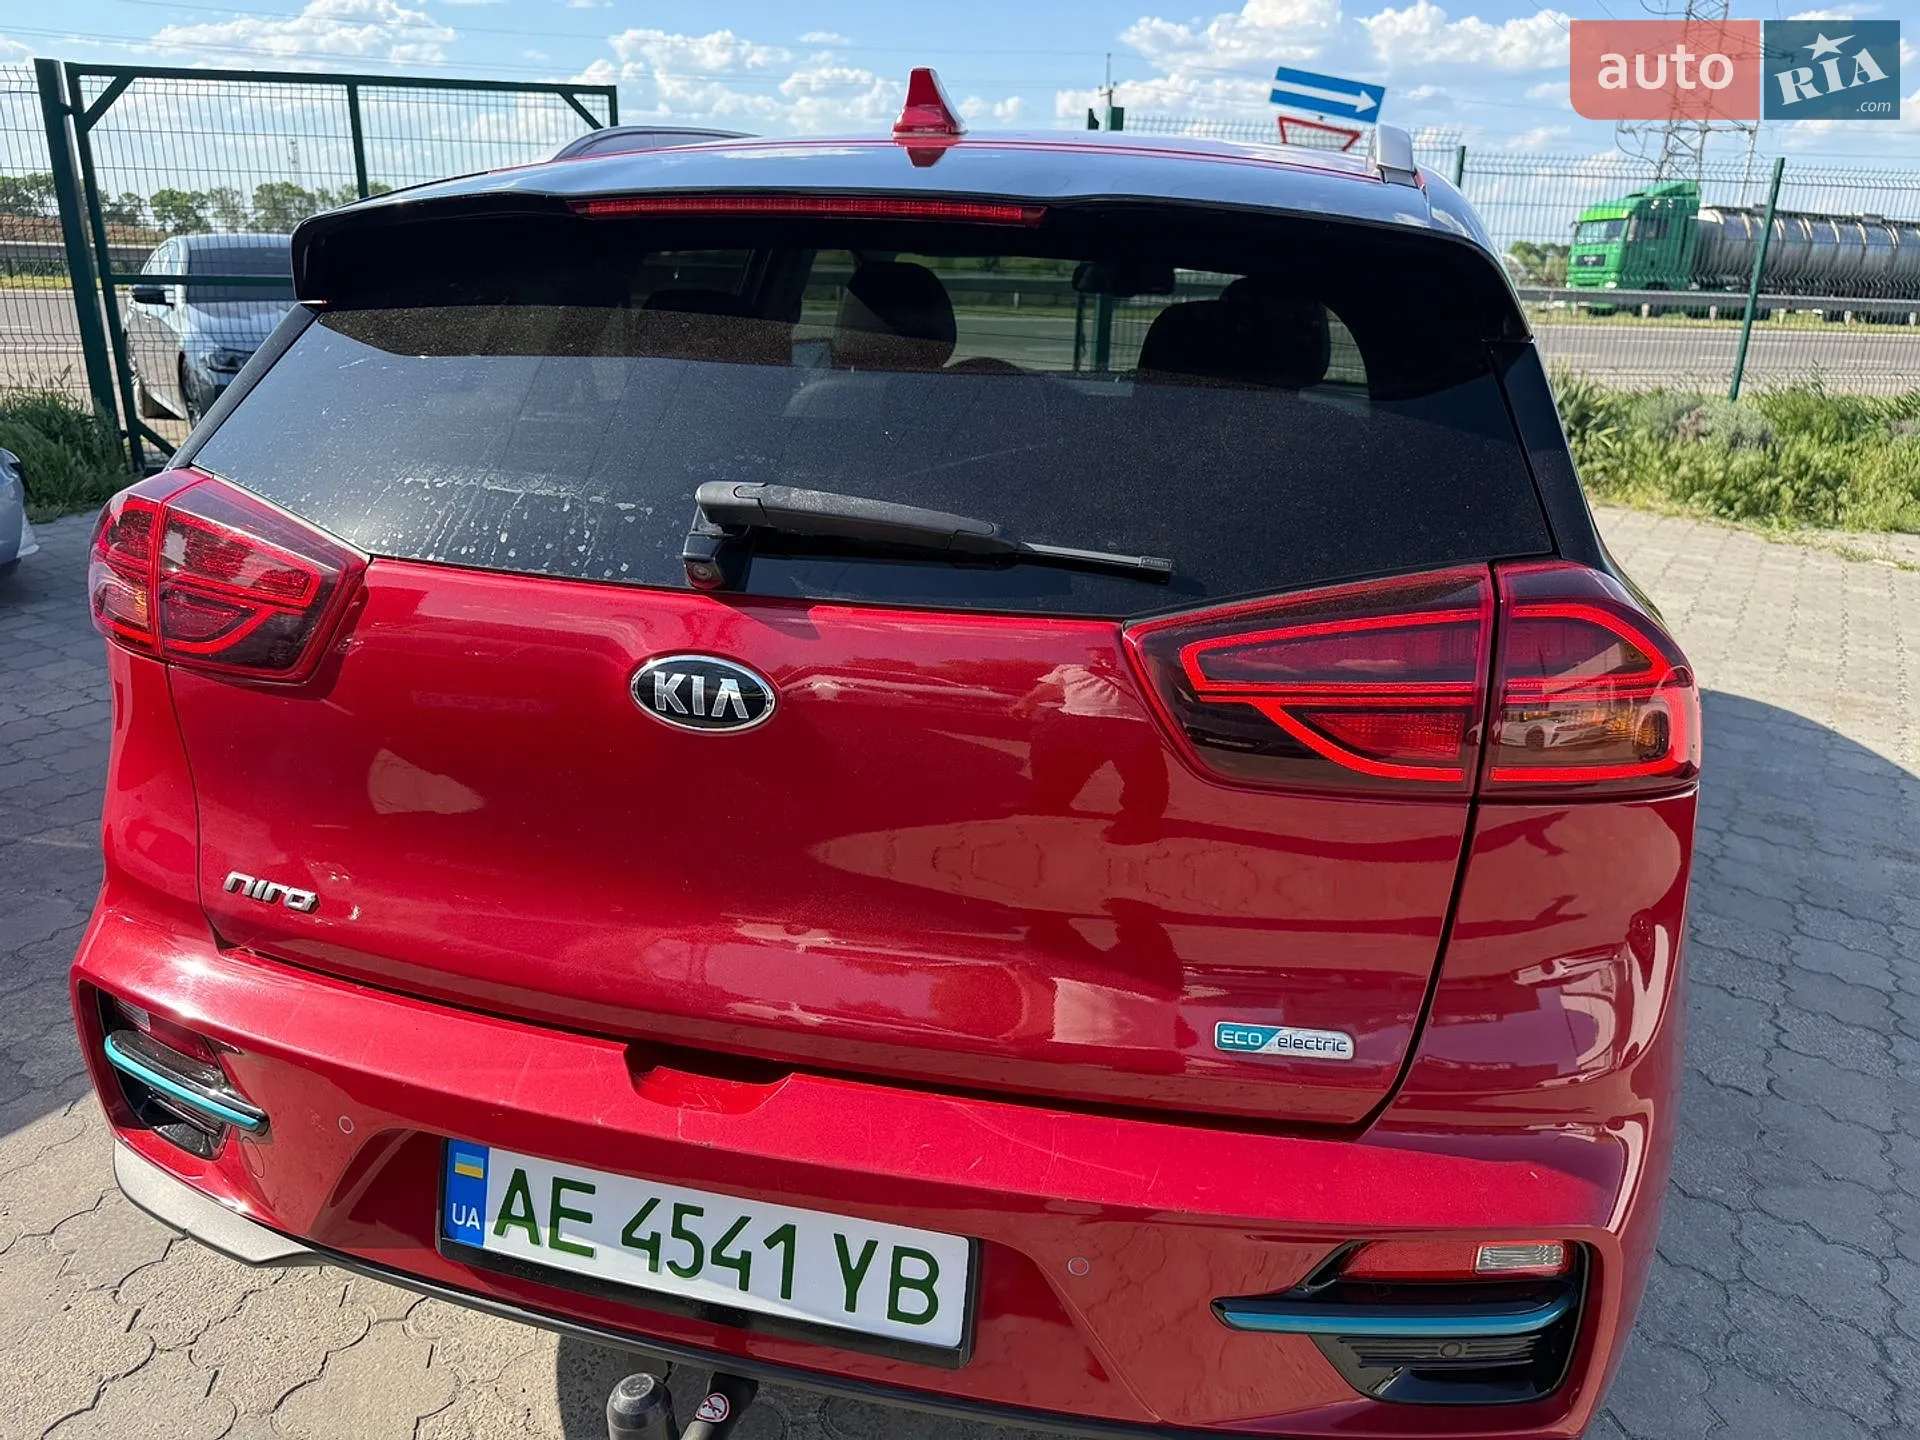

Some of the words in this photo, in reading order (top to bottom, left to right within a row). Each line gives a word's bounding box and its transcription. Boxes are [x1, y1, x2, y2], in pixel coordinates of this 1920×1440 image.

[653, 670, 749, 719] KIA
[223, 871, 317, 912] niro
[1221, 1030, 1263, 1046] ECO
[1277, 1034, 1347, 1053] electric
[451, 1202, 481, 1231] UA
[493, 1168, 596, 1258] AE
[620, 1197, 797, 1300] 4541
[833, 1233, 941, 1326] YB
